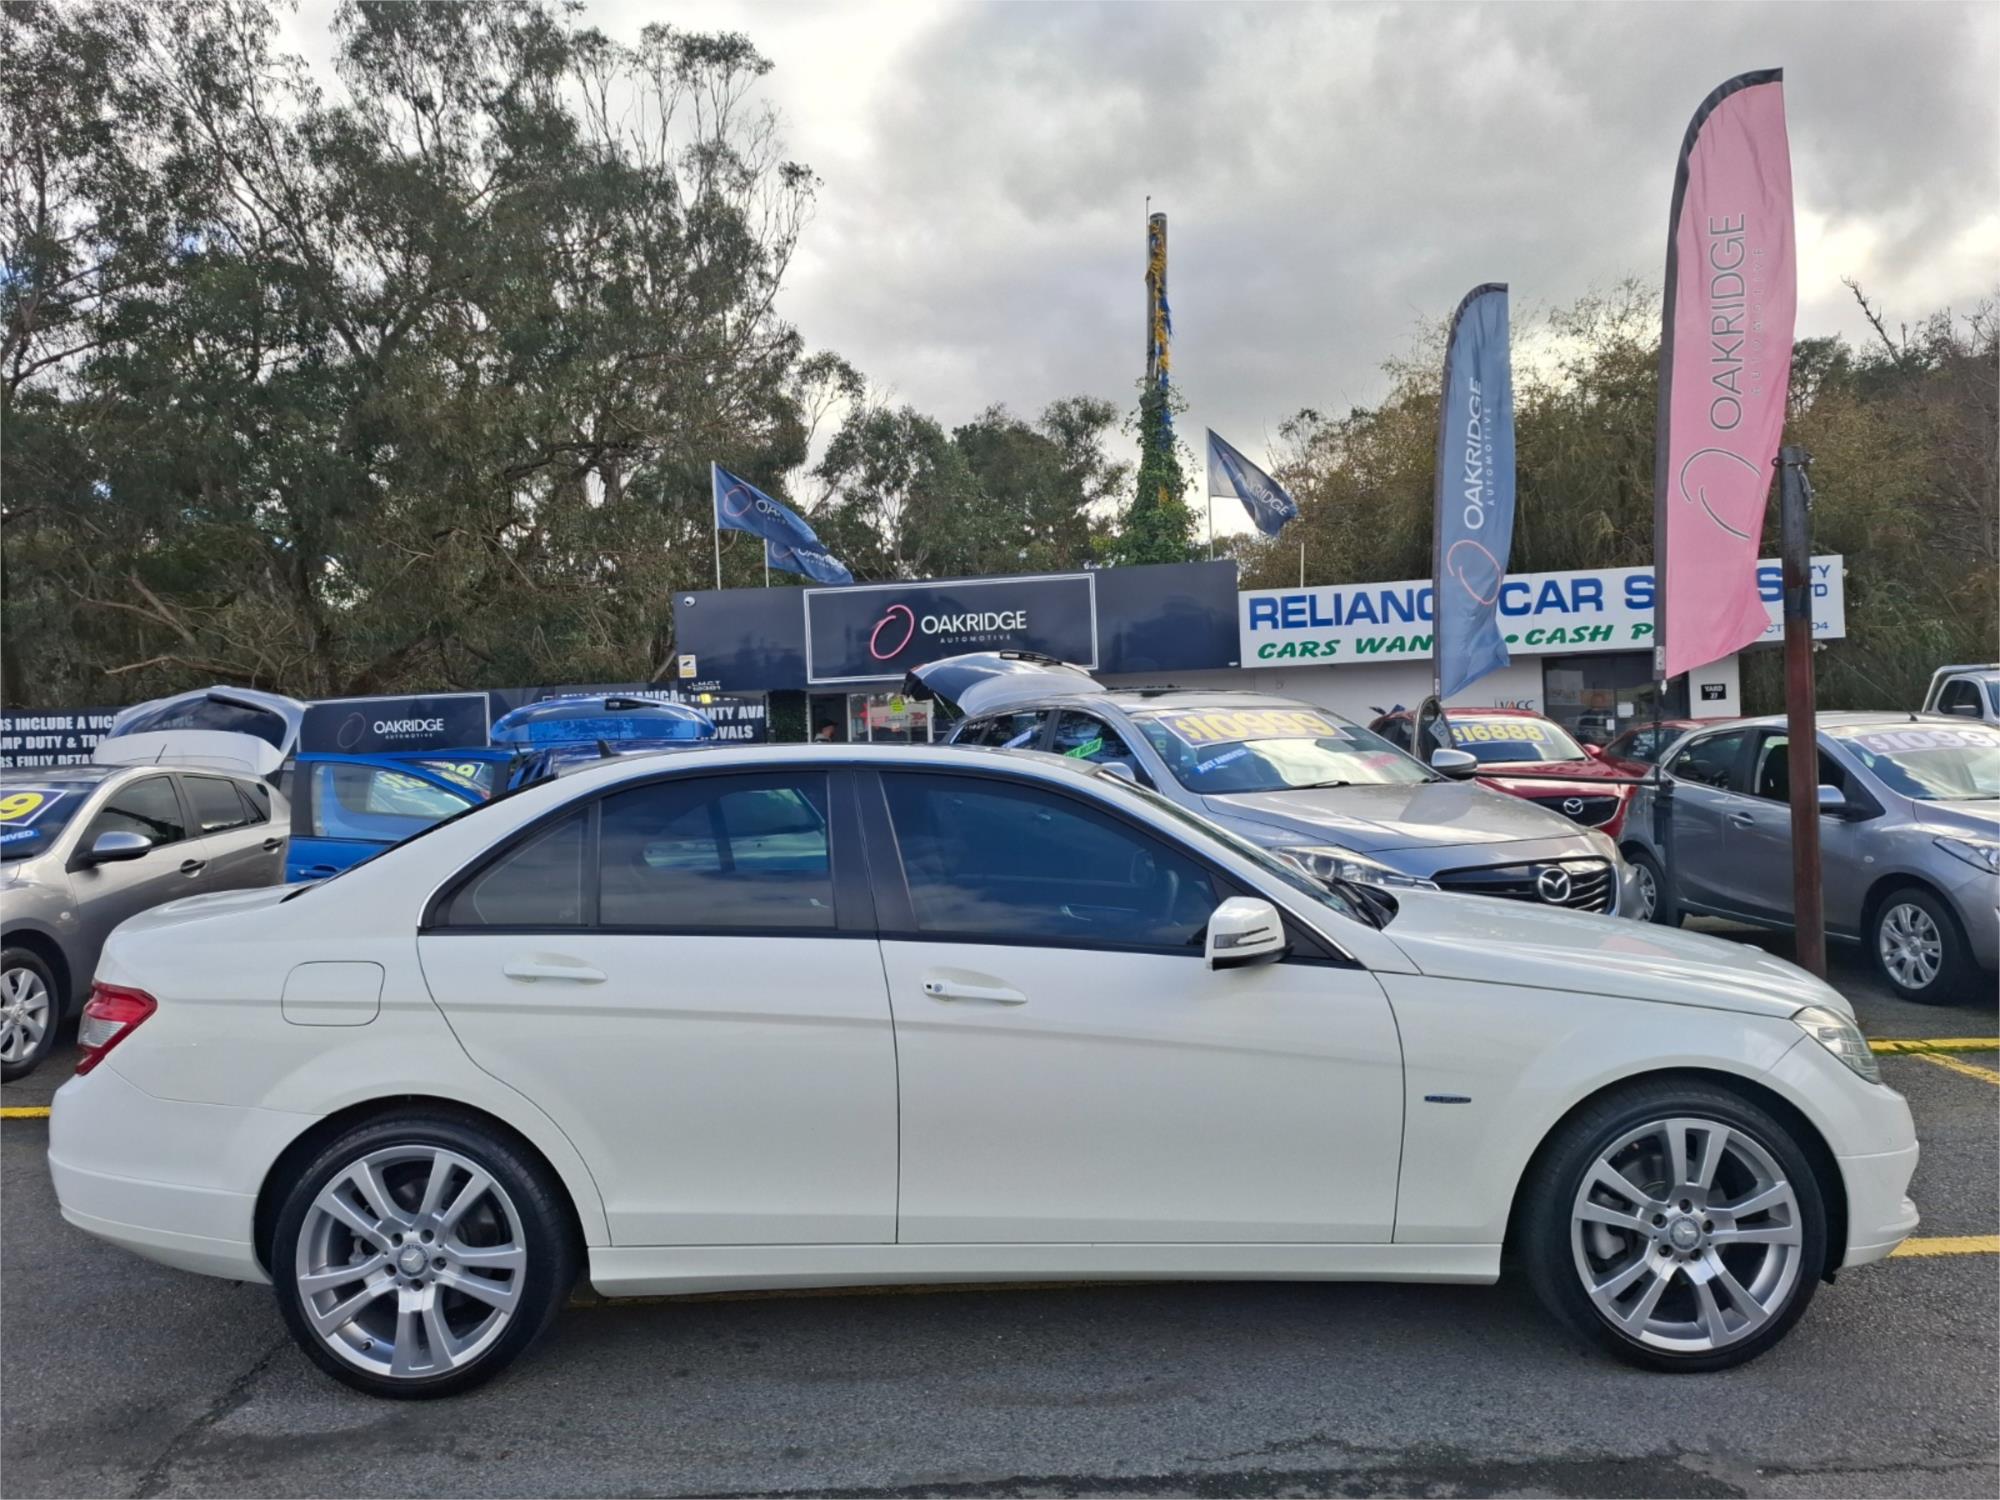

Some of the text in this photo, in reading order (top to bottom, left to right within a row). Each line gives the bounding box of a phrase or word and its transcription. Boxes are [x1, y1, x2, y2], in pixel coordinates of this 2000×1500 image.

[1710, 214, 1744, 430] OAKRIDGE
[1464, 376, 1485, 530] OAKRIDGE
[1484, 407, 1495, 506] AUTOMOTIVE
[1249, 587, 1433, 630] RELIANC
[1499, 577, 1604, 616] CAR
[921, 611, 1027, 634] OAKRIDGE
[940, 634, 1011, 643] AUTOMOTIVE
[1257, 640, 1341, 659] CARS
[1356, 634, 1434, 655] WAN
[1525, 624, 1614, 645] CASH
[15, 716, 73, 731] INCLUDE
[76, 716, 86, 730] A
[88, 715, 116, 730] VIC
[738, 705, 764, 720] AVA
[373, 718, 445, 734] OAKRIDGE
[1174, 712, 1335, 742] $10999
[1452, 726, 1545, 742] $16888
[26, 735, 62, 749] DUTY
[66, 736, 77, 749] &
[0, 792, 44, 821] 9
[0, 829, 34, 843] RIVED
